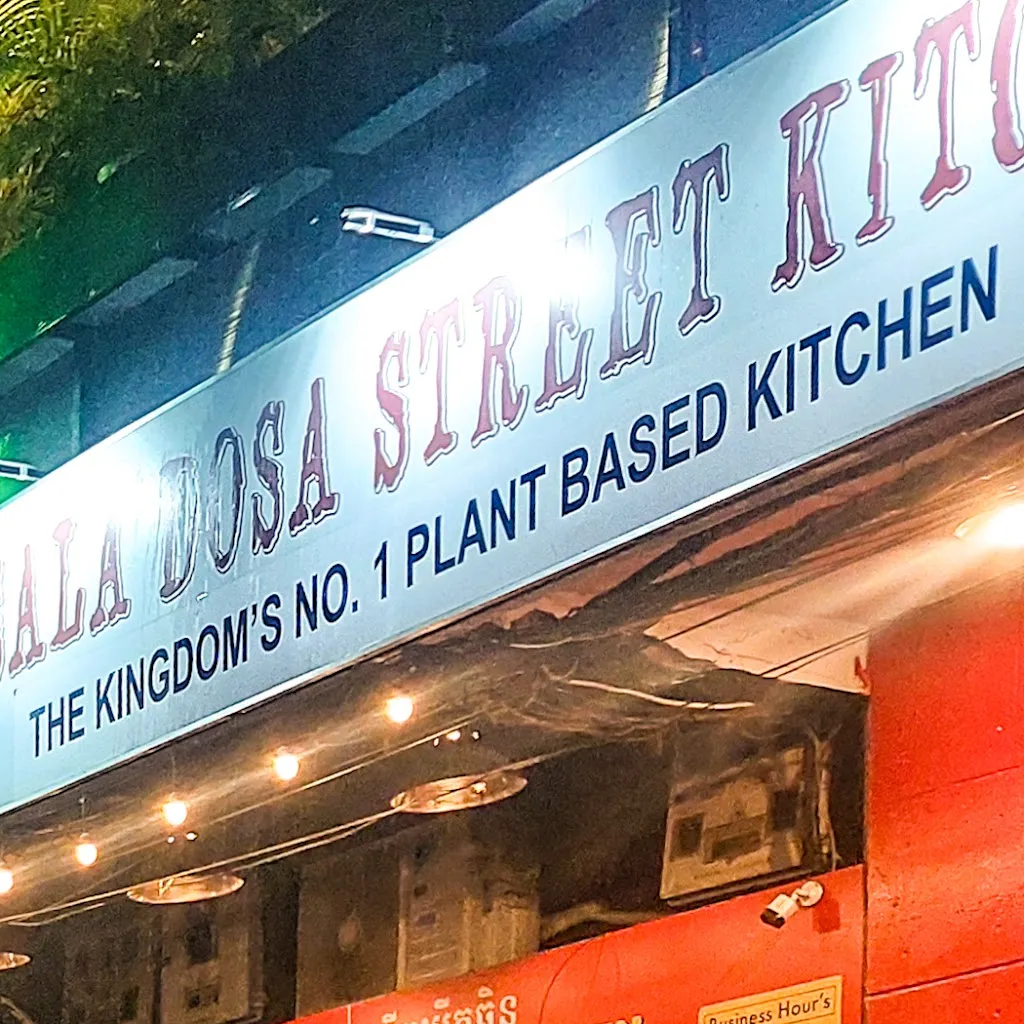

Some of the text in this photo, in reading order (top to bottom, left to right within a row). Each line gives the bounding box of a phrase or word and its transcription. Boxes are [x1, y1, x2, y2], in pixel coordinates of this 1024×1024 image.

[30, 246, 998, 758] THE KINGDOM'S NO. 1 PLANT BASED KITCHEN
[158, 376, 340, 603] DOSA
[373, 142, 731, 494] STREET
[777, 992, 832, 1019] Hour's
